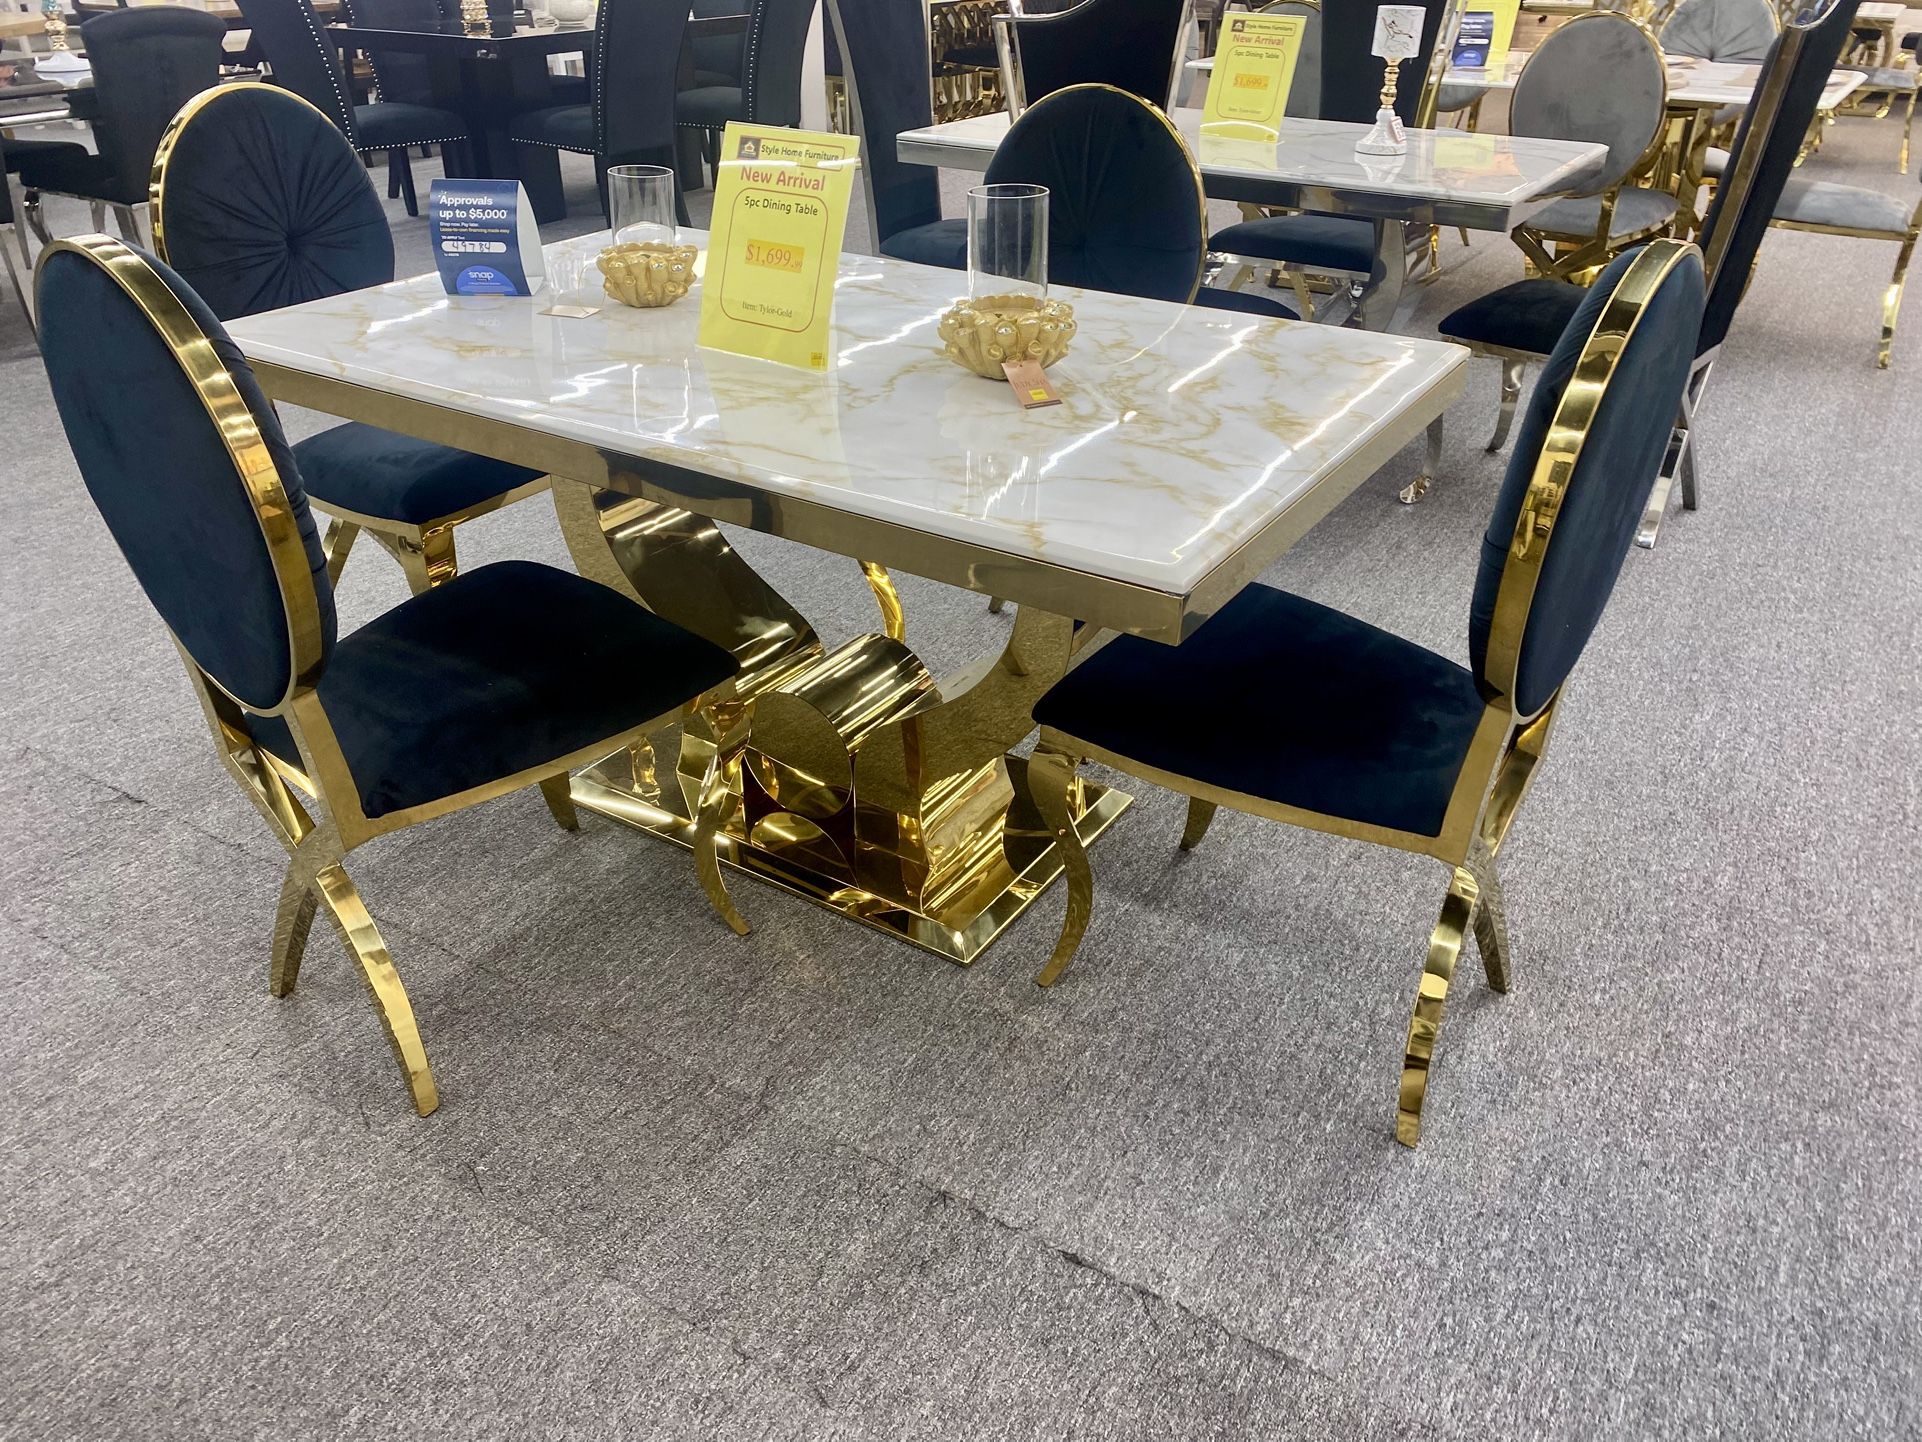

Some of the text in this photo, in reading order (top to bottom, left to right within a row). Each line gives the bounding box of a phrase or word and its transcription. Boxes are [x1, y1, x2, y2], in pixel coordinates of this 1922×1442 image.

[1233, 34, 1285, 46] New Arrival
[1245, 51, 1264, 59] Dining
[761, 144, 780, 156] Style
[781, 148, 802, 157] Home
[805, 149, 840, 161] Furniture
[740, 166, 826, 192] New Arrival
[440, 195, 493, 206] Approvals
[744, 196, 818, 216] 5pc Dining Table
[439, 209, 453, 220] up
[455, 208, 467, 217] to
[745, 244, 803, 268] $1,699.99
[468, 271, 494, 281] snap
[742, 300, 758, 311] Item:
